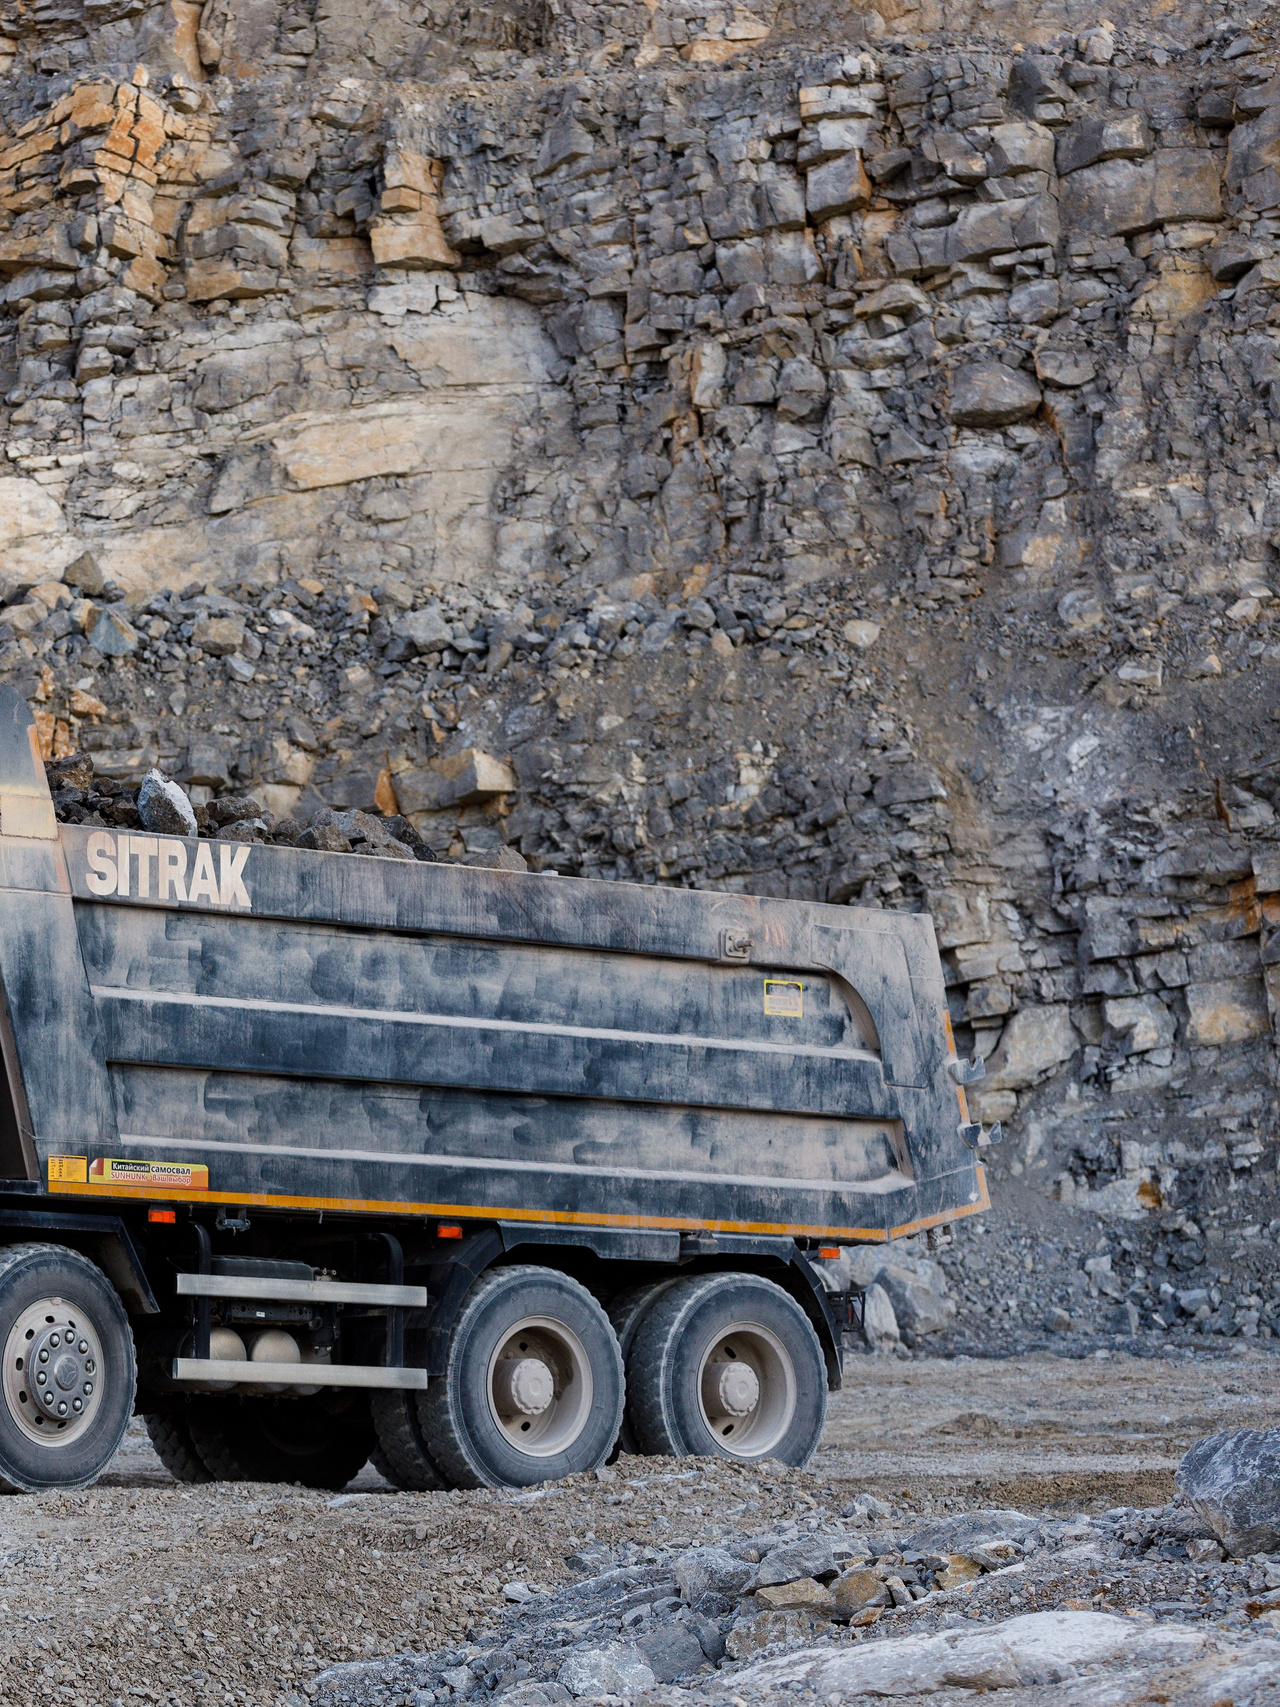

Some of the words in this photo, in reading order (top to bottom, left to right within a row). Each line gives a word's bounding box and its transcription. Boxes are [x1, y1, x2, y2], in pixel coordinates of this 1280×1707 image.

[86, 832, 252, 907] SITRAK
[112, 1162, 149, 1172] Китайский
[151, 1166, 190, 1175] самосвал
[111, 1172, 146, 1181] SUNHUNK
[168, 1175, 191, 1185] выбор
